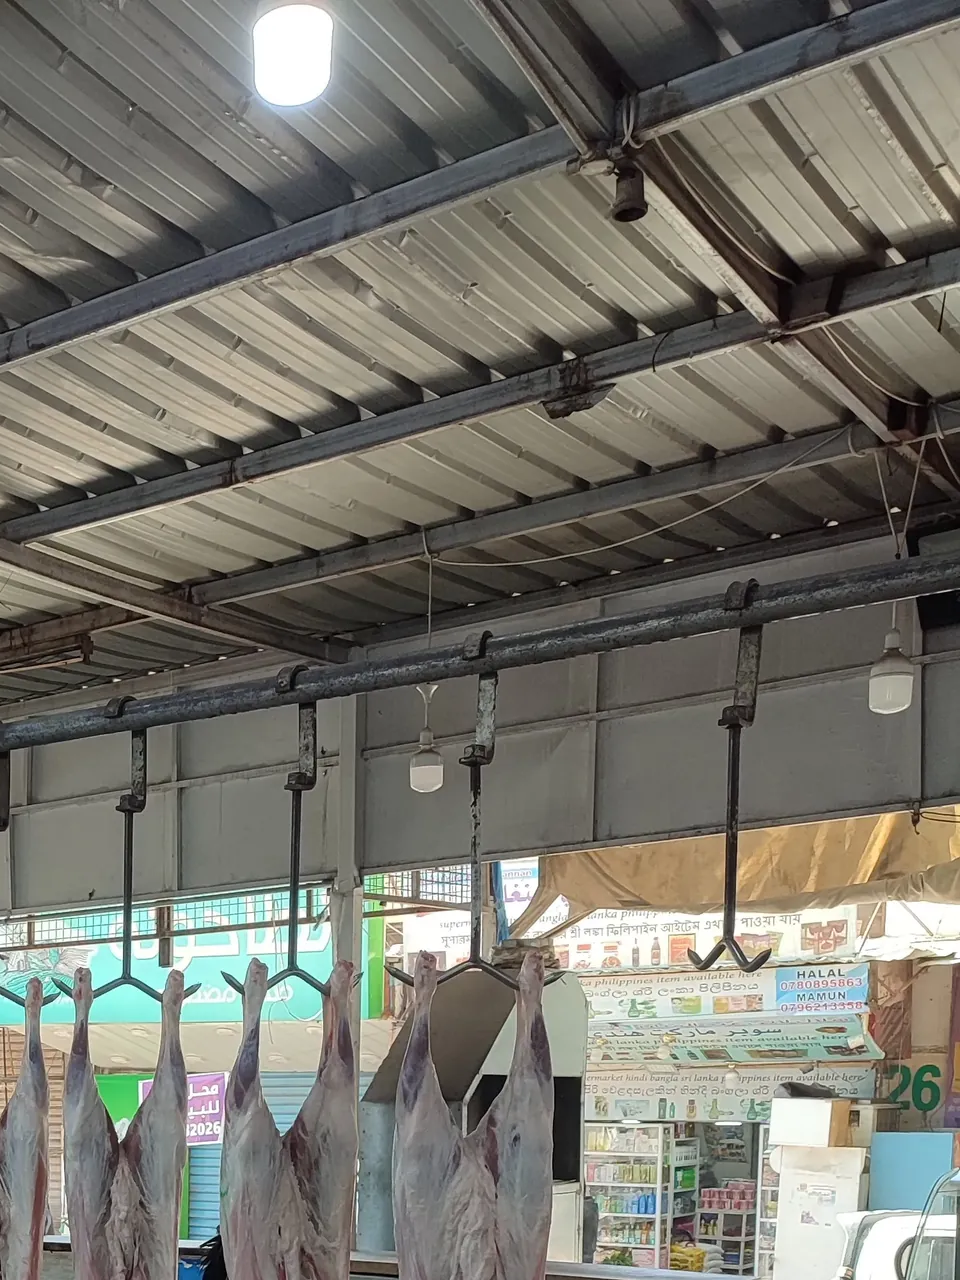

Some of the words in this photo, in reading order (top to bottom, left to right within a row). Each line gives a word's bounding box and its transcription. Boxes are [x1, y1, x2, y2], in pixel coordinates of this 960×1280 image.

[595, 976, 654, 988] philippines
[657, 975, 681, 984] item
[684, 971, 734, 982] available
[738, 970, 763, 979] here
[797, 968, 846, 979] HALAL
[780, 977, 863, 991] 0780895863
[796, 991, 846, 1002] MAMUN
[780, 1001, 863, 1013] 0796213358
[625, 1073, 648, 1082] hindi
[650, 1073, 678, 1083] bangla
[680, 1074, 692, 1082] sri
[694, 1073, 719, 1082] lanka
[773, 1073, 793, 1082] item
[796, 1073, 840, 1082] available
[842, 1073, 862, 1081] here
[887, 1064, 942, 1112] 26
